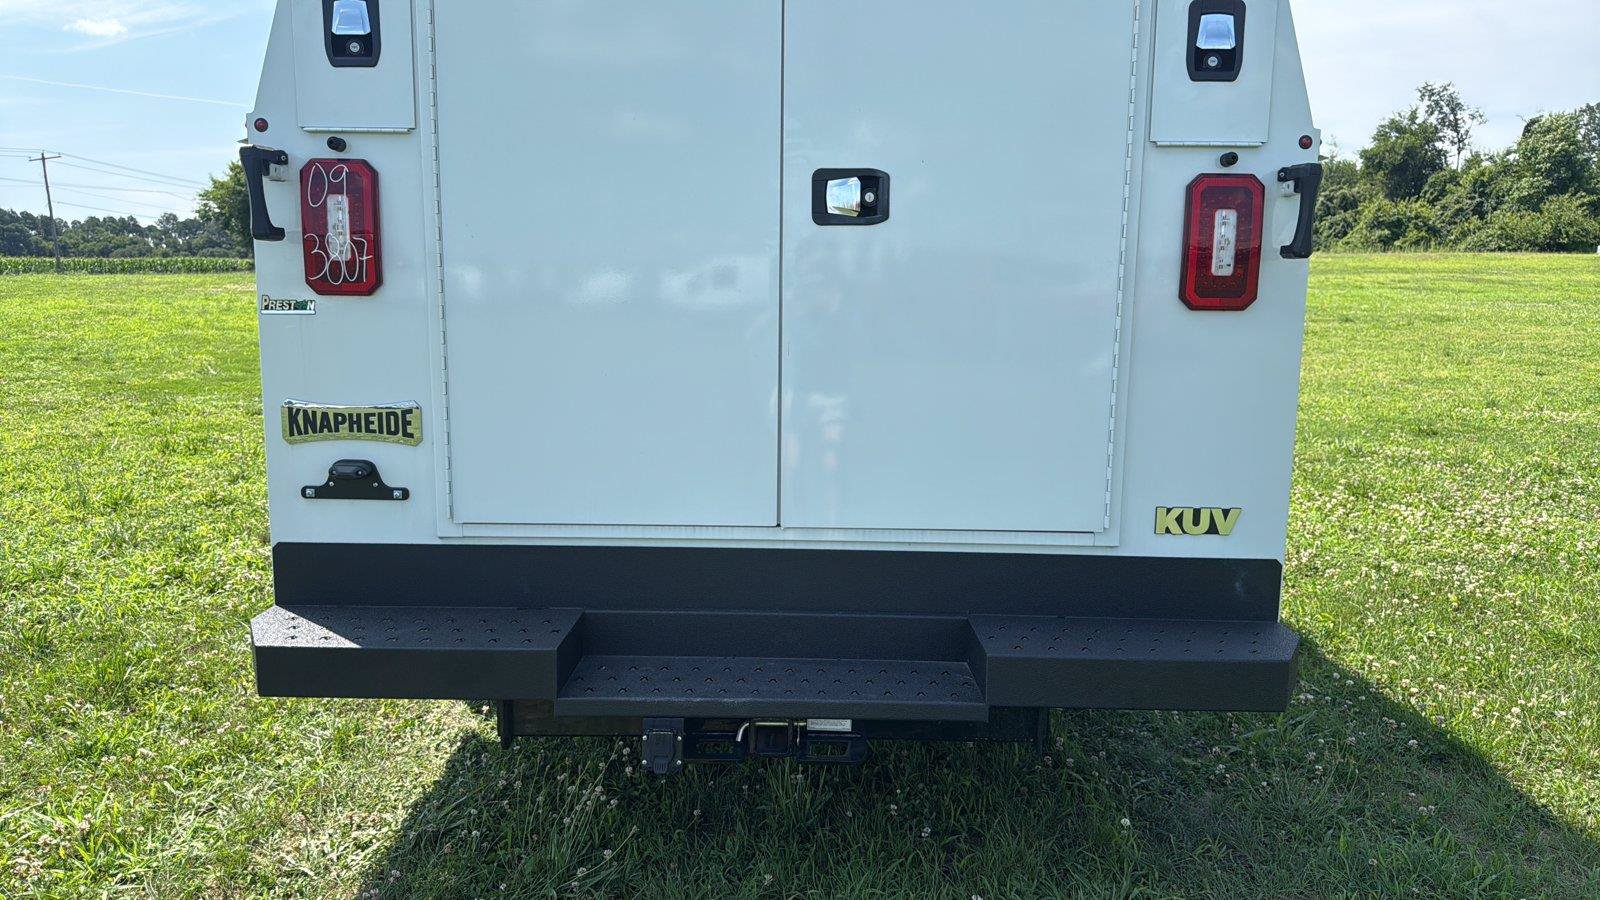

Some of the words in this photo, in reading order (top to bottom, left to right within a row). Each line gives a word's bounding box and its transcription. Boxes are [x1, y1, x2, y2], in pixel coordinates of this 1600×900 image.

[308, 163, 349, 215] 09
[304, 233, 374, 285] 3807
[261, 295, 316, 311] PRESTN
[287, 407, 415, 439] KNAPHEIDE
[1154, 506, 1242, 536] KUV
